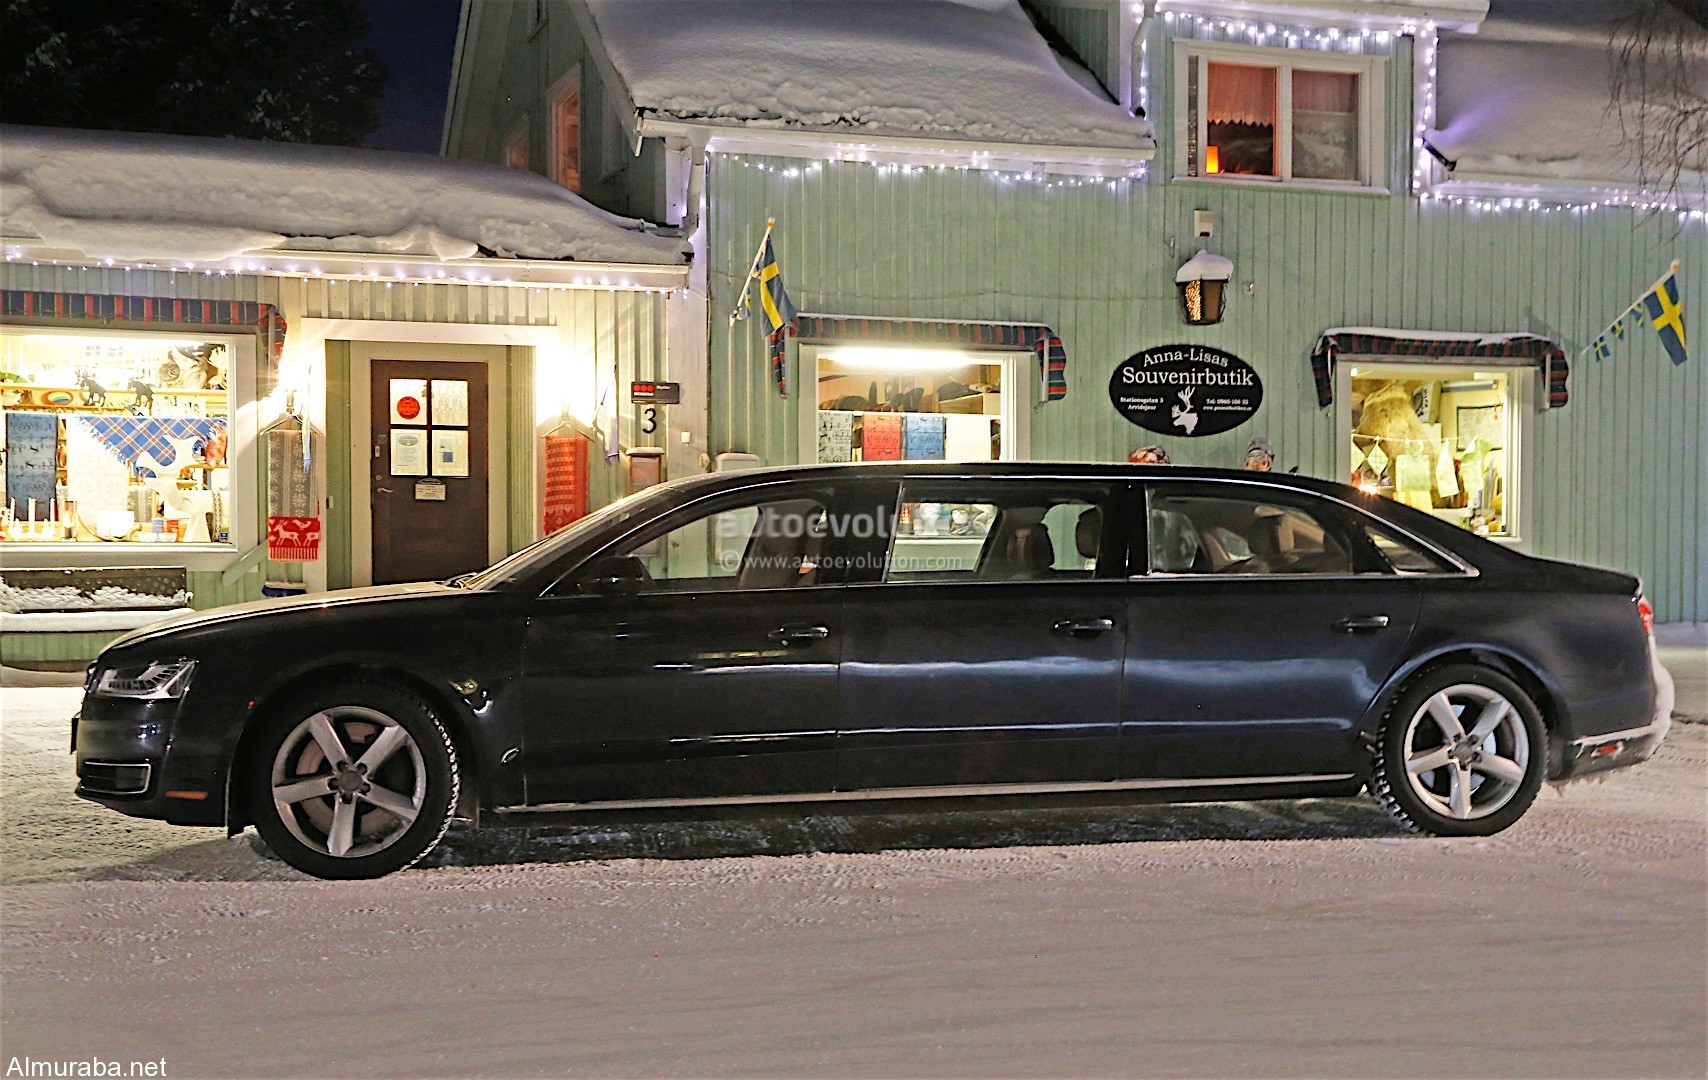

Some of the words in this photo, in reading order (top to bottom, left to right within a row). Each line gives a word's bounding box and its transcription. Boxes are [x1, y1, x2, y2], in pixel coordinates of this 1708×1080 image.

[1143, 348, 1229, 367] Anna-Lisas
[1123, 367, 1254, 386] Souvenirbutik
[642, 408, 657, 434] 3
